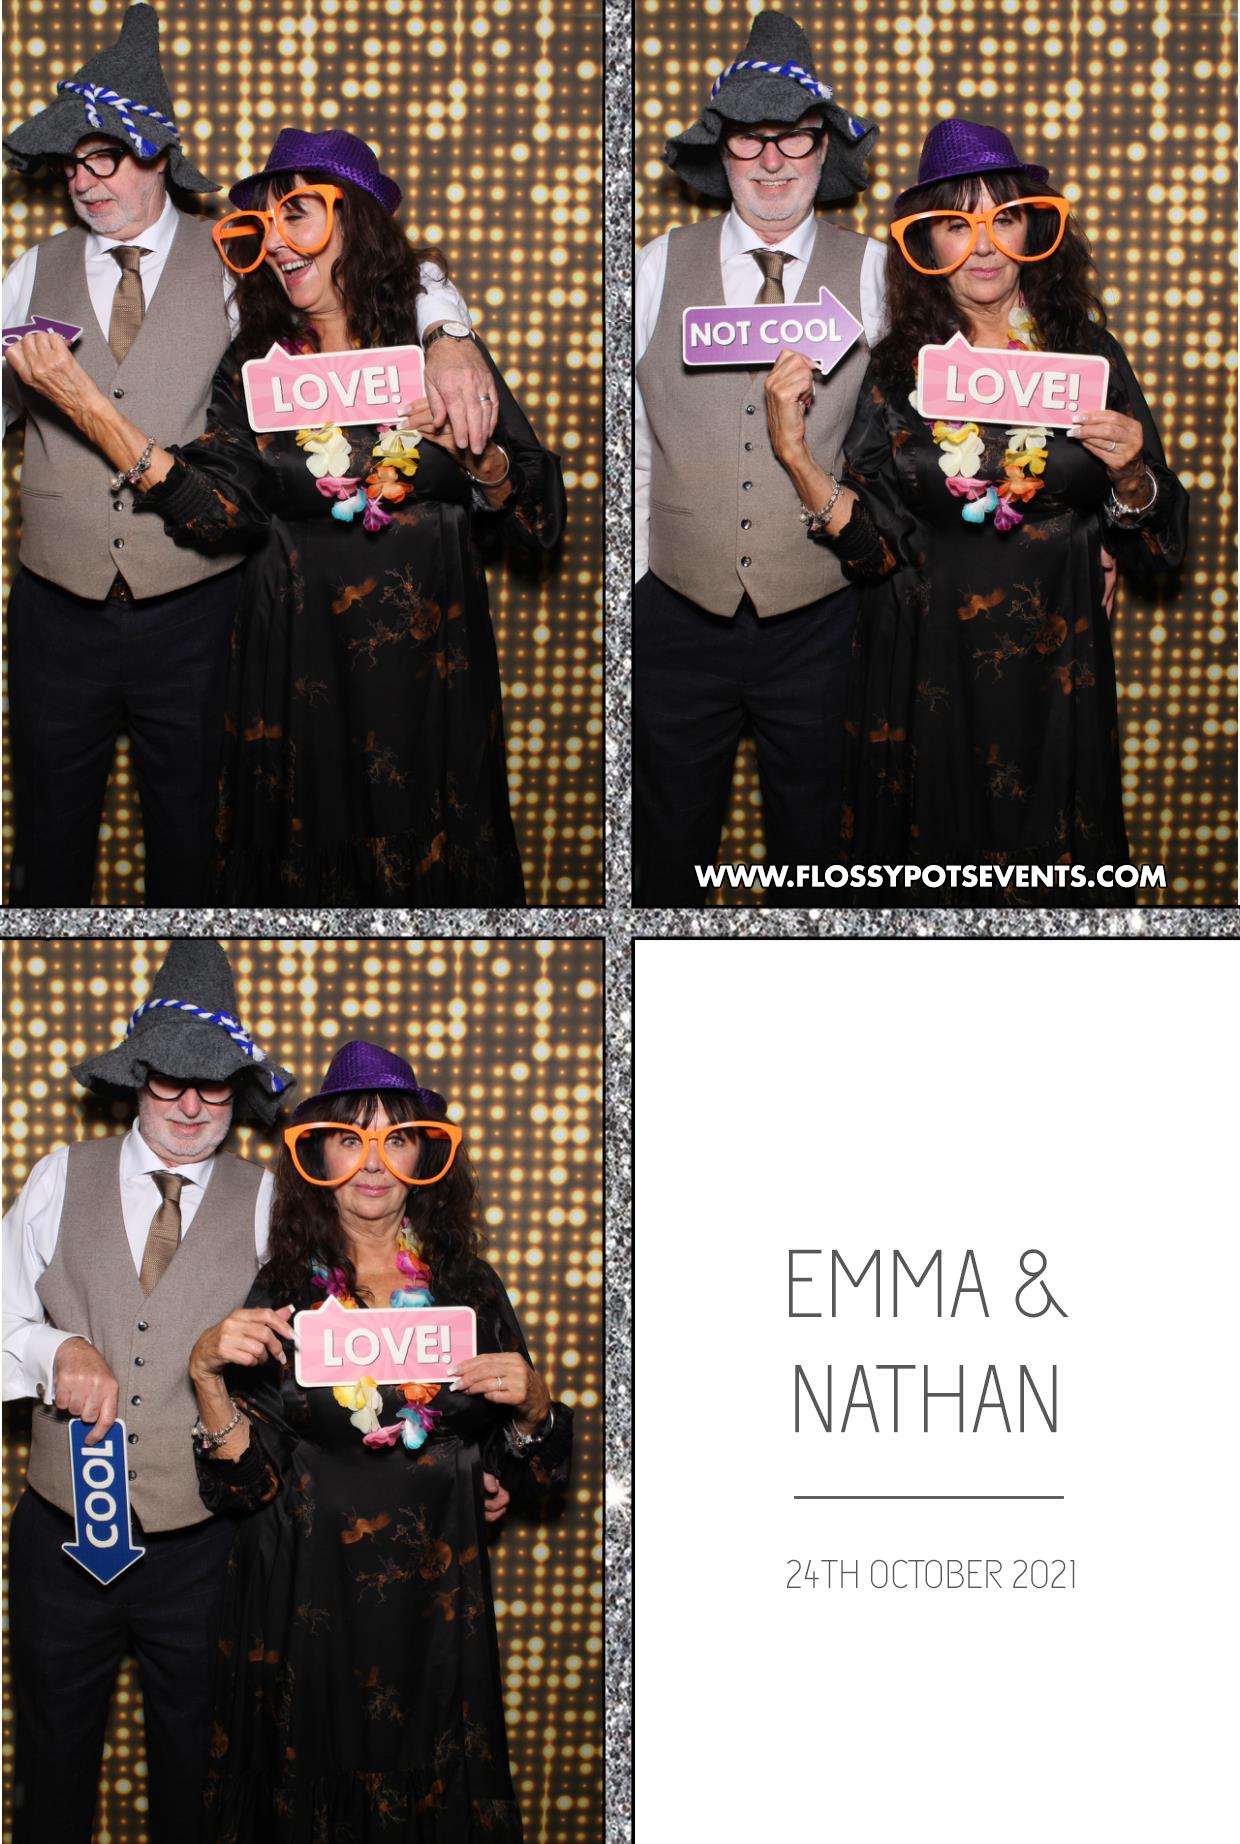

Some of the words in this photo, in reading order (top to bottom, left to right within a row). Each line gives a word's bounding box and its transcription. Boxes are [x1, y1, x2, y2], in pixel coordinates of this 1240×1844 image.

[690, 321, 752, 347] NOT
[759, 318, 842, 344] COOL
[271, 365, 402, 413] LOVE!
[946, 365, 1081, 412] LOVE!
[323, 1325, 452, 1366] LOVE!
[81, 1440, 119, 1549] COOL
